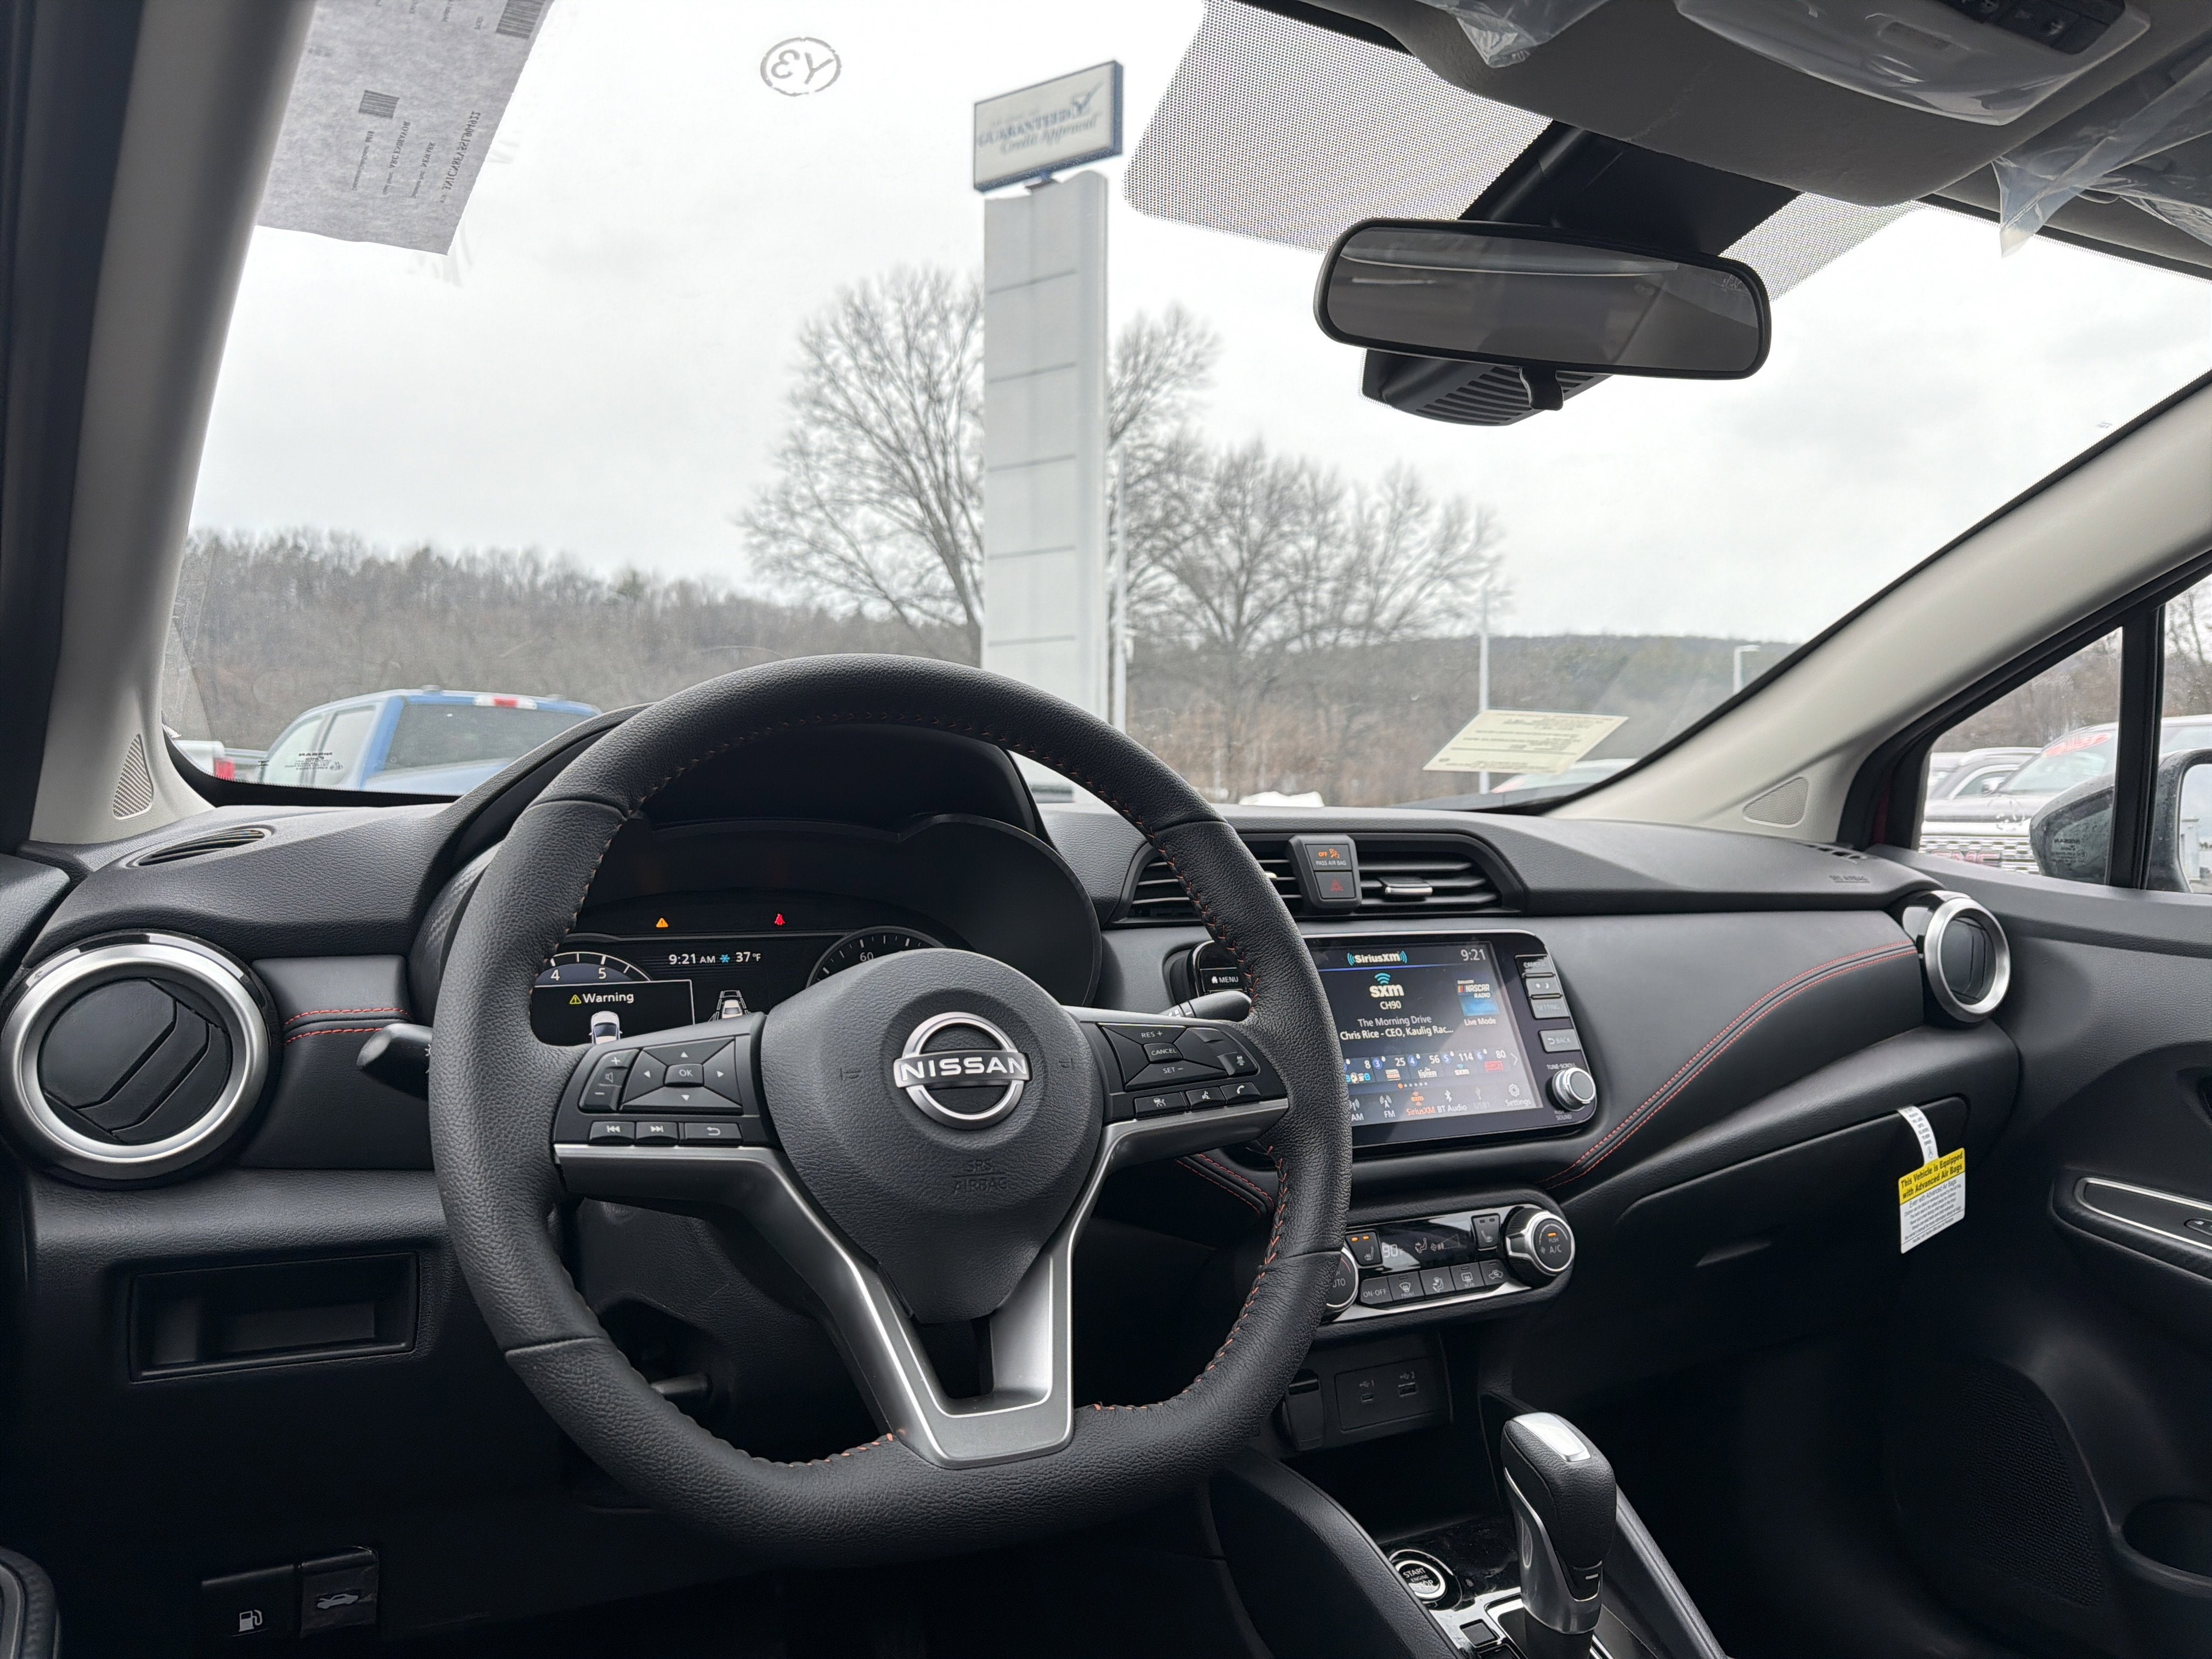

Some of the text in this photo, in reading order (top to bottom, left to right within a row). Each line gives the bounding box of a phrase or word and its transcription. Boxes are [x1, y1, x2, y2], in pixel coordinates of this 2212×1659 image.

[669, 953, 716, 964] 9:21 AM
[860, 952, 874, 962] 60
[1460, 949, 1486, 961] 9:21
[550, 969, 560, 981] 4
[598, 967, 607, 979] 5
[1465, 983, 1490, 992] NASCAR
[582, 992, 634, 1003] Warning
[1380, 1000, 1402, 1009] CH90
[1357, 1015, 1432, 1027] The Morning Drive
[1340, 1030, 1361, 1041] Chris
[1362, 1029, 1379, 1039] Rice
[1406, 1026, 1432, 1037] Kaulig
[1429, 1054, 1440, 1064] 56
[1459, 1052, 1474, 1062] 114
[1496, 1049, 1506, 1059] 80
[1364, 1059, 1371, 1069] 8
[1394, 1057, 1406, 1066] 25
[678, 1069, 693, 1077] OK
[900, 1057, 1028, 1081] NISSAN
[1447, 1103, 1468, 1112] Audio
[1505, 1098, 1532, 1107] Settings
[1406, 1106, 1436, 1116] SiriusXM
[1351, 1113, 1364, 1121] AM
[1900, 1176, 1912, 1189] This
[1913, 1167, 1933, 1182] Vehicle
[1939, 1150, 1963, 1169] Equipped
[1903, 1187, 1914, 1200] with
[1915, 1172, 1940, 1193] Advanced
[1950, 1163, 1962, 1175] Bags
[1549, 1244, 1562, 1255] A/C
[1403, 1567, 1426, 1578] START
